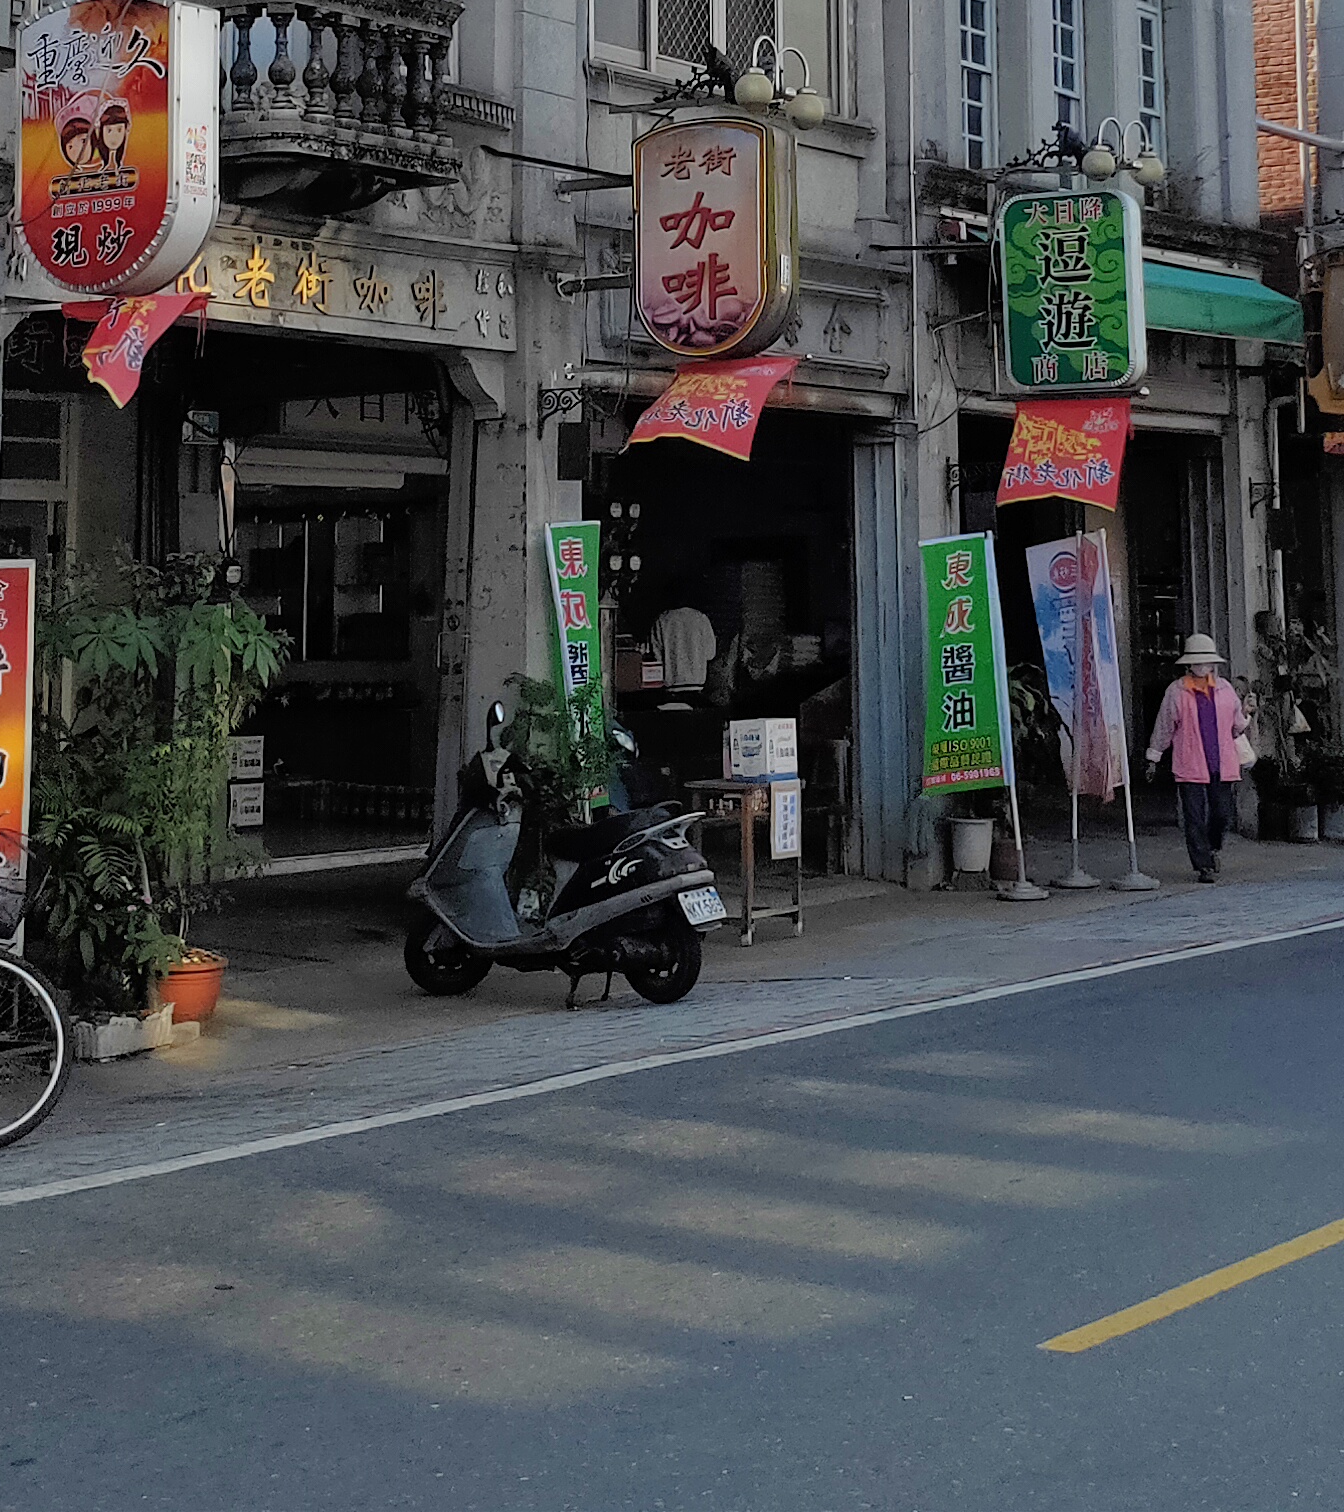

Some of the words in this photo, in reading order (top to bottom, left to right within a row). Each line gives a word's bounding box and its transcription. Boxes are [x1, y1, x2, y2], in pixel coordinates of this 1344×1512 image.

[659, 145, 737, 180] 老街
[50, 218, 135, 267] 現炒
[659, 191, 738, 321] 咖啡
[1036, 225, 1097, 353] 逗遊
[1031, 352, 1109, 384] 商店
[940, 549, 976, 733] 東成醬油
